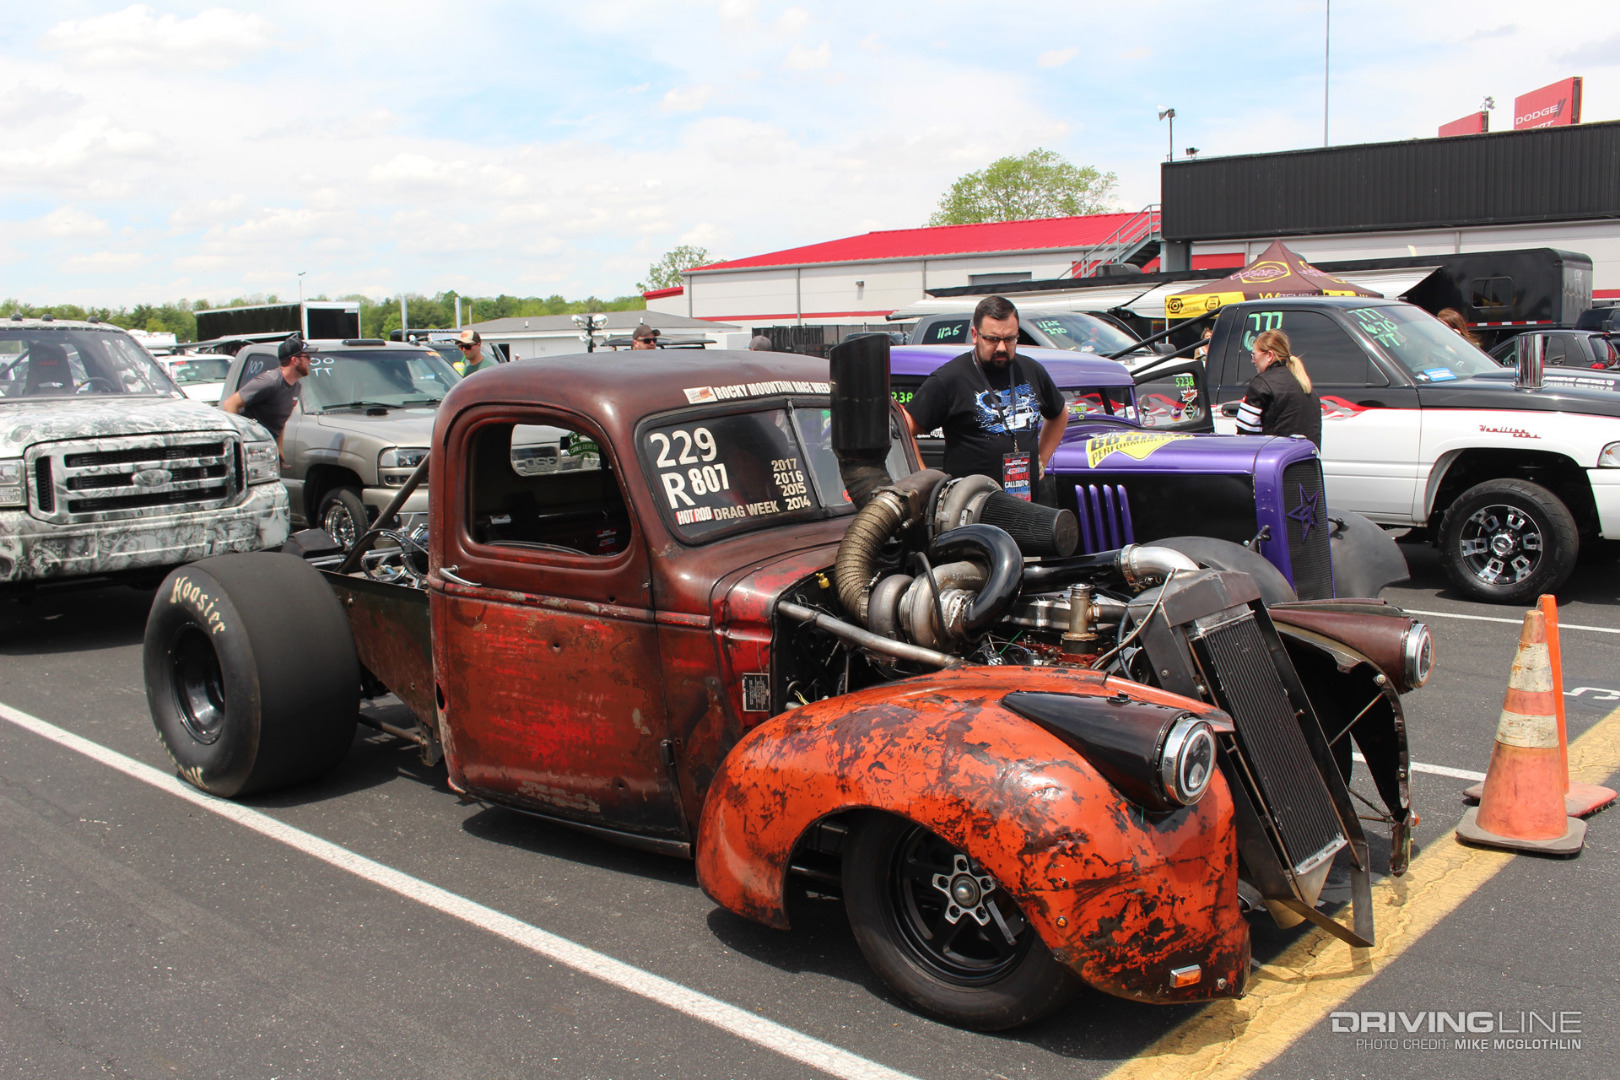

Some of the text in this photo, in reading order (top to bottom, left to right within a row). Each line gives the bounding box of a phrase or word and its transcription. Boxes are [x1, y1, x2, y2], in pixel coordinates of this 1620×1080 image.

[1515, 104, 1559, 125] DODGE
[1248, 311, 1284, 332] 777
[1346, 308, 1385, 322] 777
[713, 384, 749, 400] ROCKY
[746, 380, 796, 396] MOUNTAIN
[791, 381, 815, 394] RACE
[1175, 376, 1195, 388] 5238
[649, 427, 718, 469] 229
[771, 458, 798, 472] 2017
[660, 462, 730, 510] R 807
[773, 470, 804, 486] 2016
[780, 482, 807, 497] 2015
[677, 495, 811, 526] HOT ROD DRAG WEEK 2014
